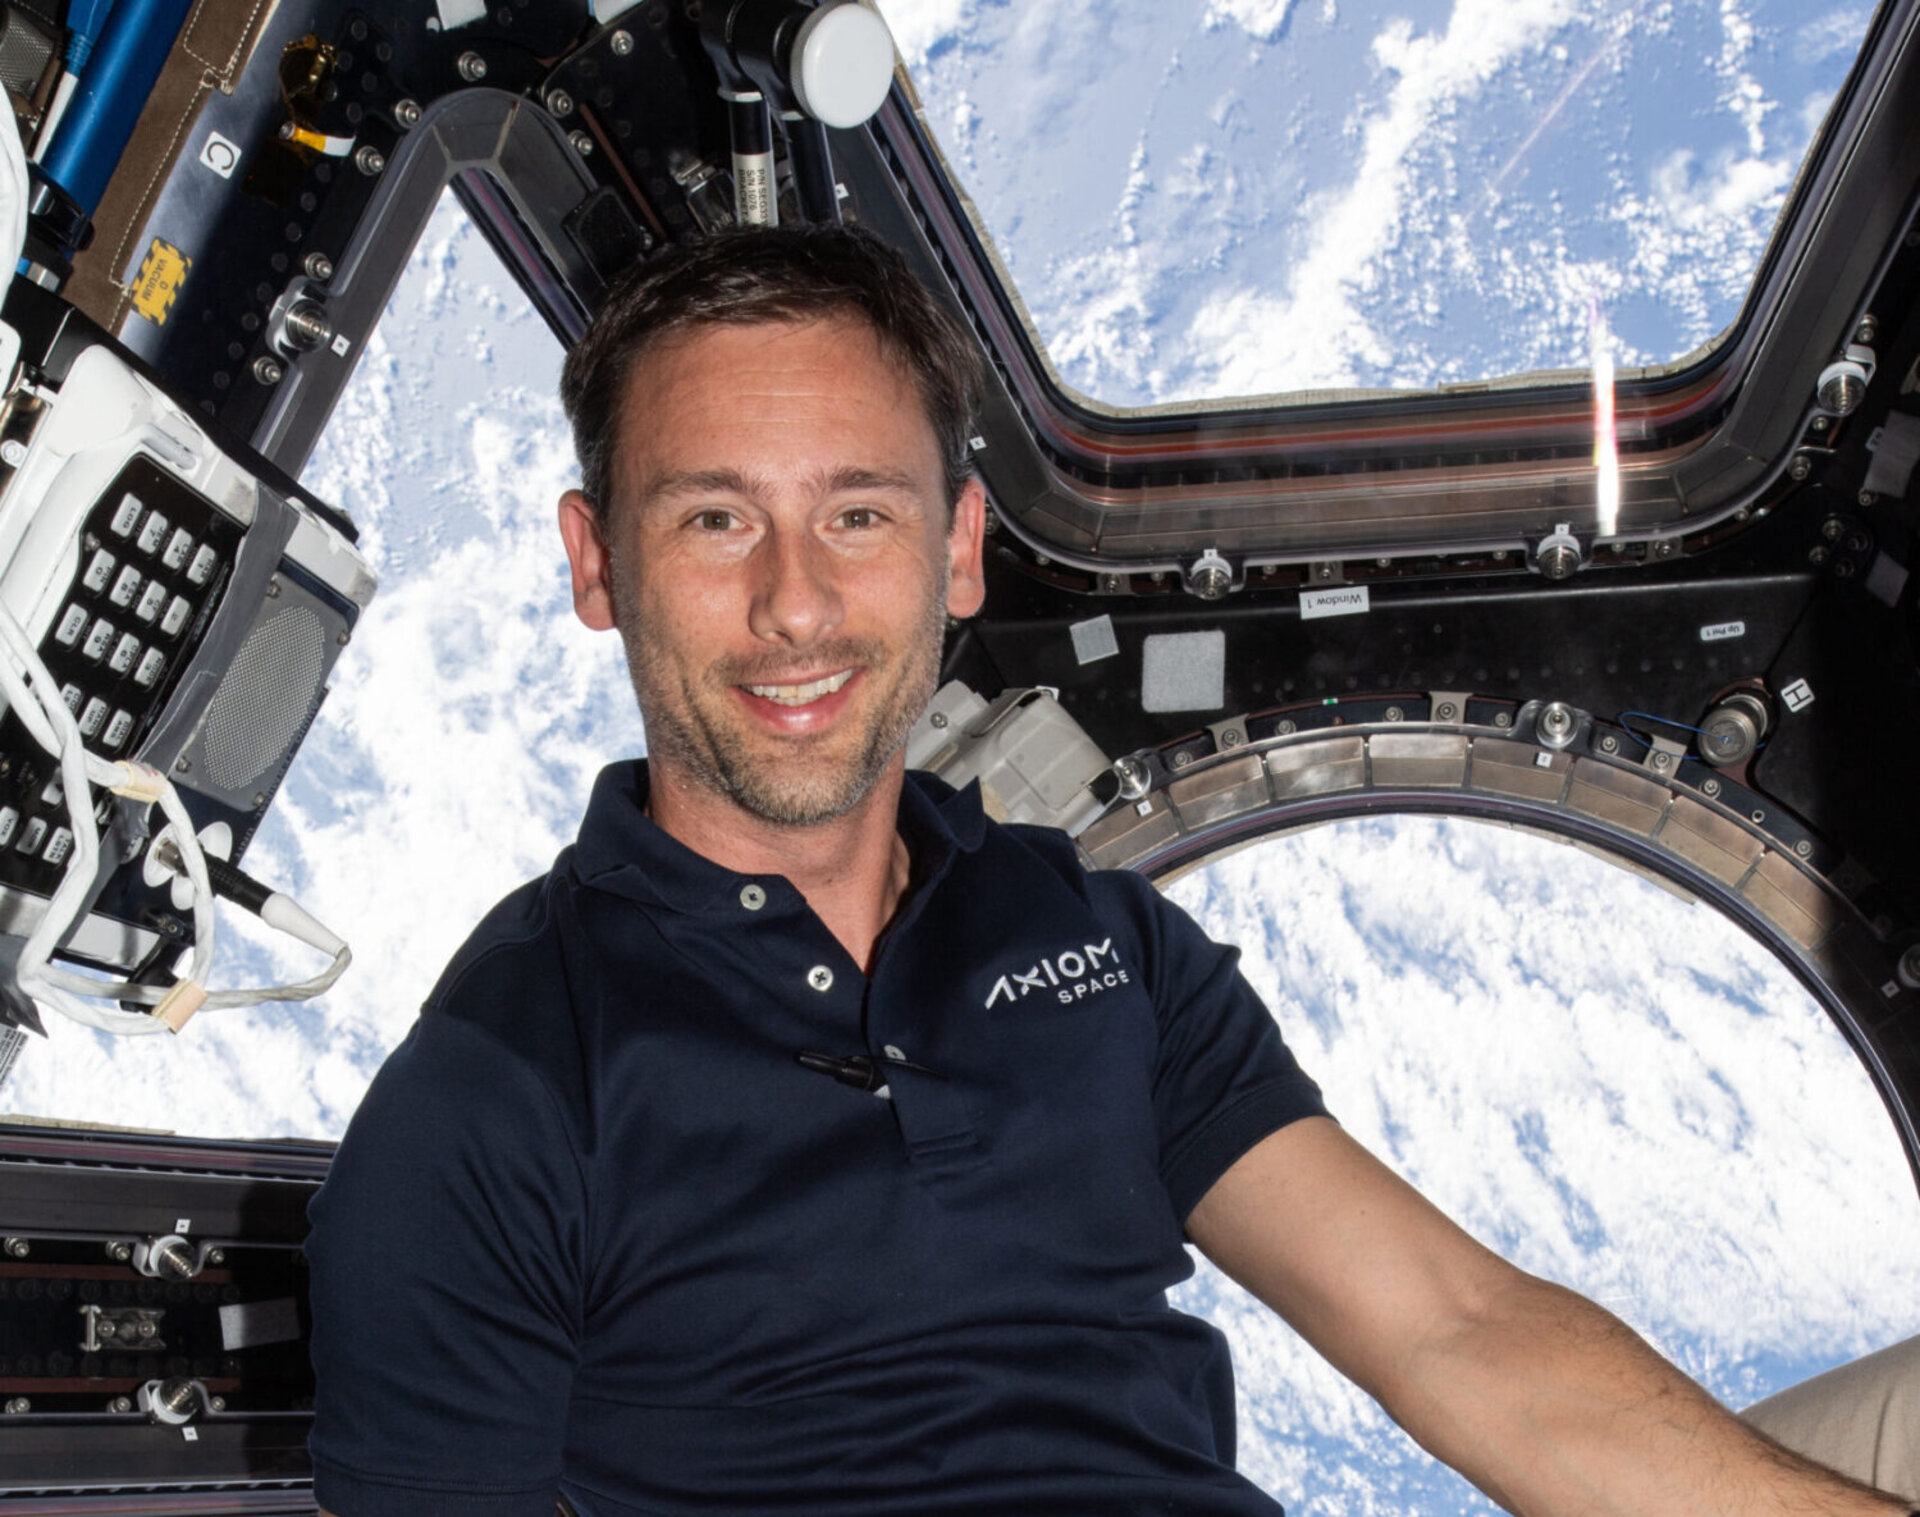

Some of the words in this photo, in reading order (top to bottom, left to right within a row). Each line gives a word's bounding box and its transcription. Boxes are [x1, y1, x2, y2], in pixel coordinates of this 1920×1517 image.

[206, 138, 235, 171] C
[141, 258, 168, 301] VACUUM
[122, 507, 136, 529] LOG
[1316, 594, 1361, 607] Window
[67, 616, 80, 637] CLR
[254, 753, 293, 821] TERMINAL
[234, 826, 254, 859] UNIT
[985, 936, 1120, 1010] AXIOM
[1057, 969, 1130, 1004] SPACE
